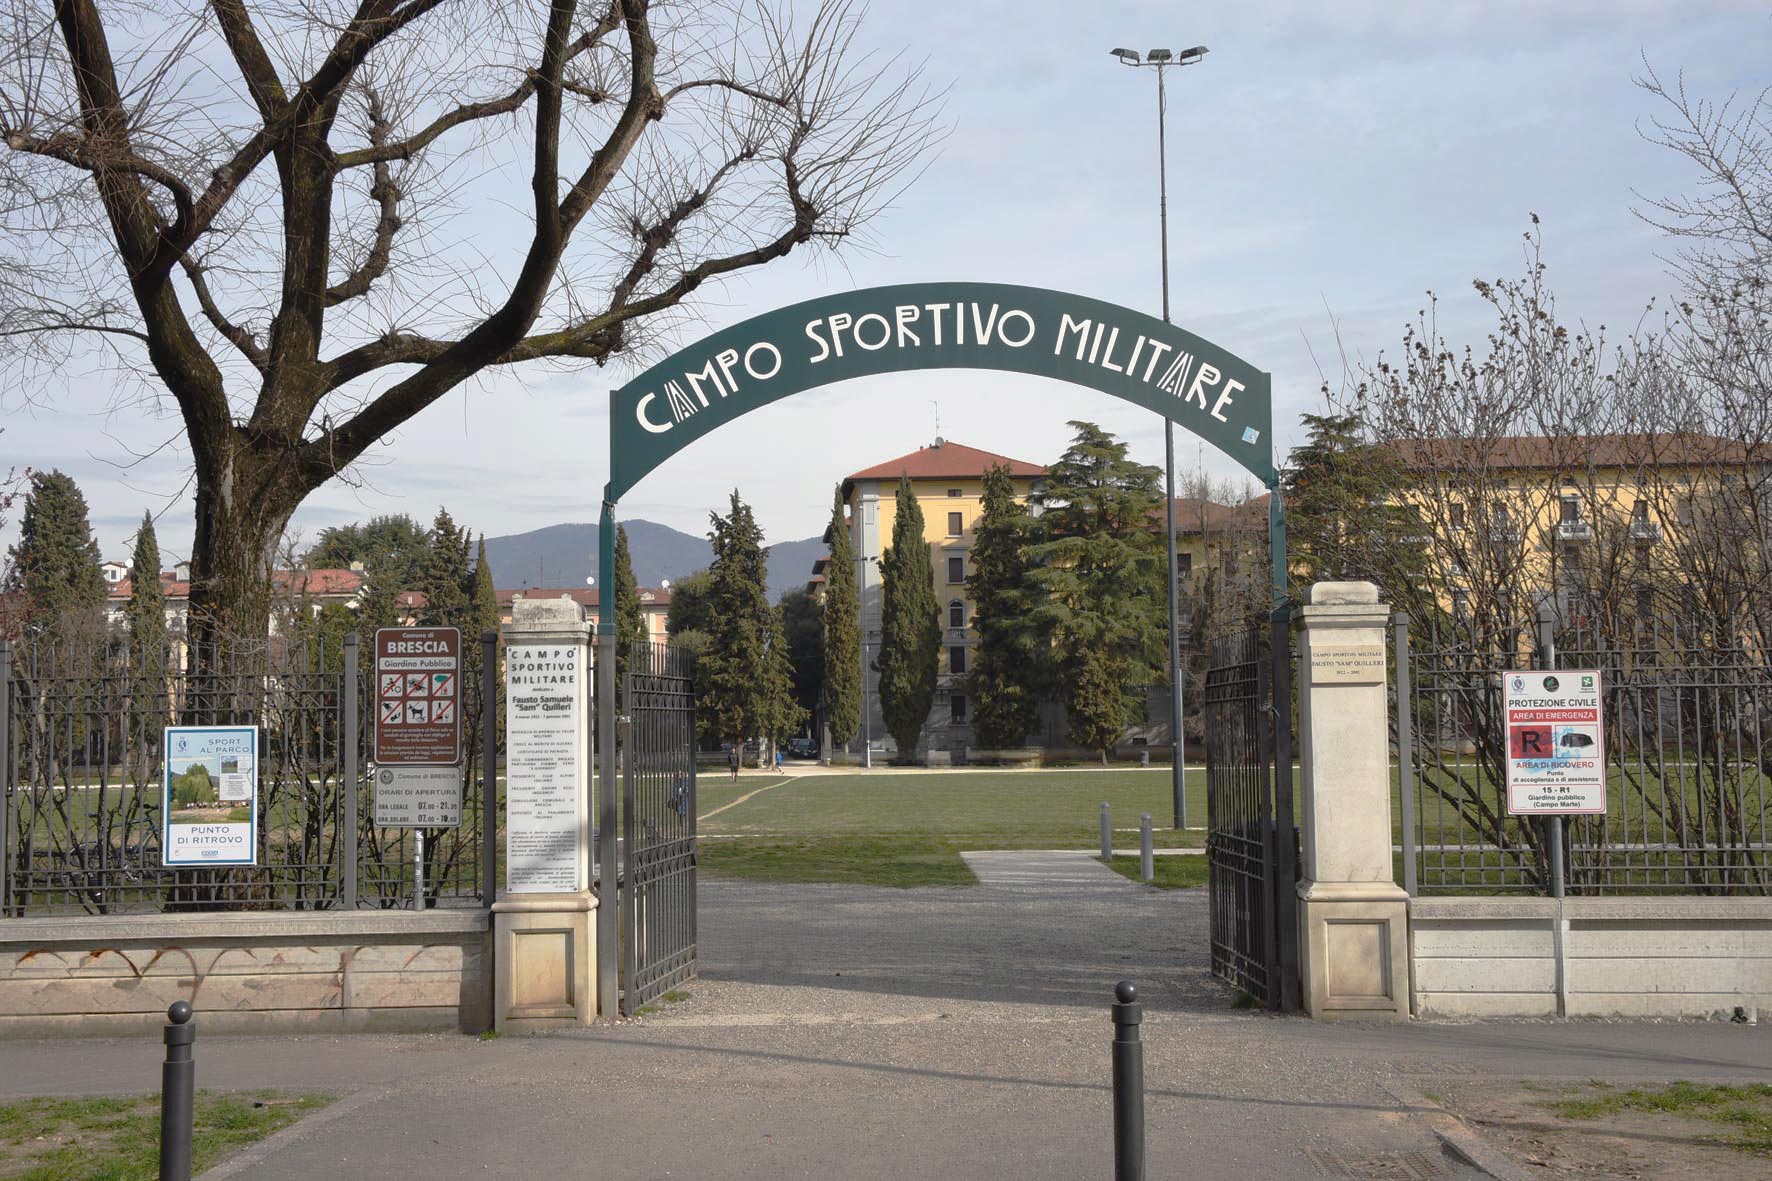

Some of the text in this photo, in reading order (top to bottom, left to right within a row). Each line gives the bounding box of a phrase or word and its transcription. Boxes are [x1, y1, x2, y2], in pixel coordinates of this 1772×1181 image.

[636, 302, 1245, 433] CAMPO SPORTIVO MILITARE
[387, 641, 449, 653] BRESCIA
[511, 650, 574, 659] CAMPO
[420, 659, 452, 667] Pubblico
[511, 663, 574, 671] SPORTIVO
[512, 675, 574, 684] MILITARE
[512, 695, 539, 703] Fausto
[1508, 698, 1597, 707] PROTEZIONE CIVILE
[542, 703, 571, 711] Quilleri
[1545, 711, 1594, 719] EMERGENZA
[208, 738, 240, 746] SPORT
[1521, 731, 1542, 753] R
[1551, 761, 1594, 769] RICOVERO
[193, 836, 243, 844] RITROVO
